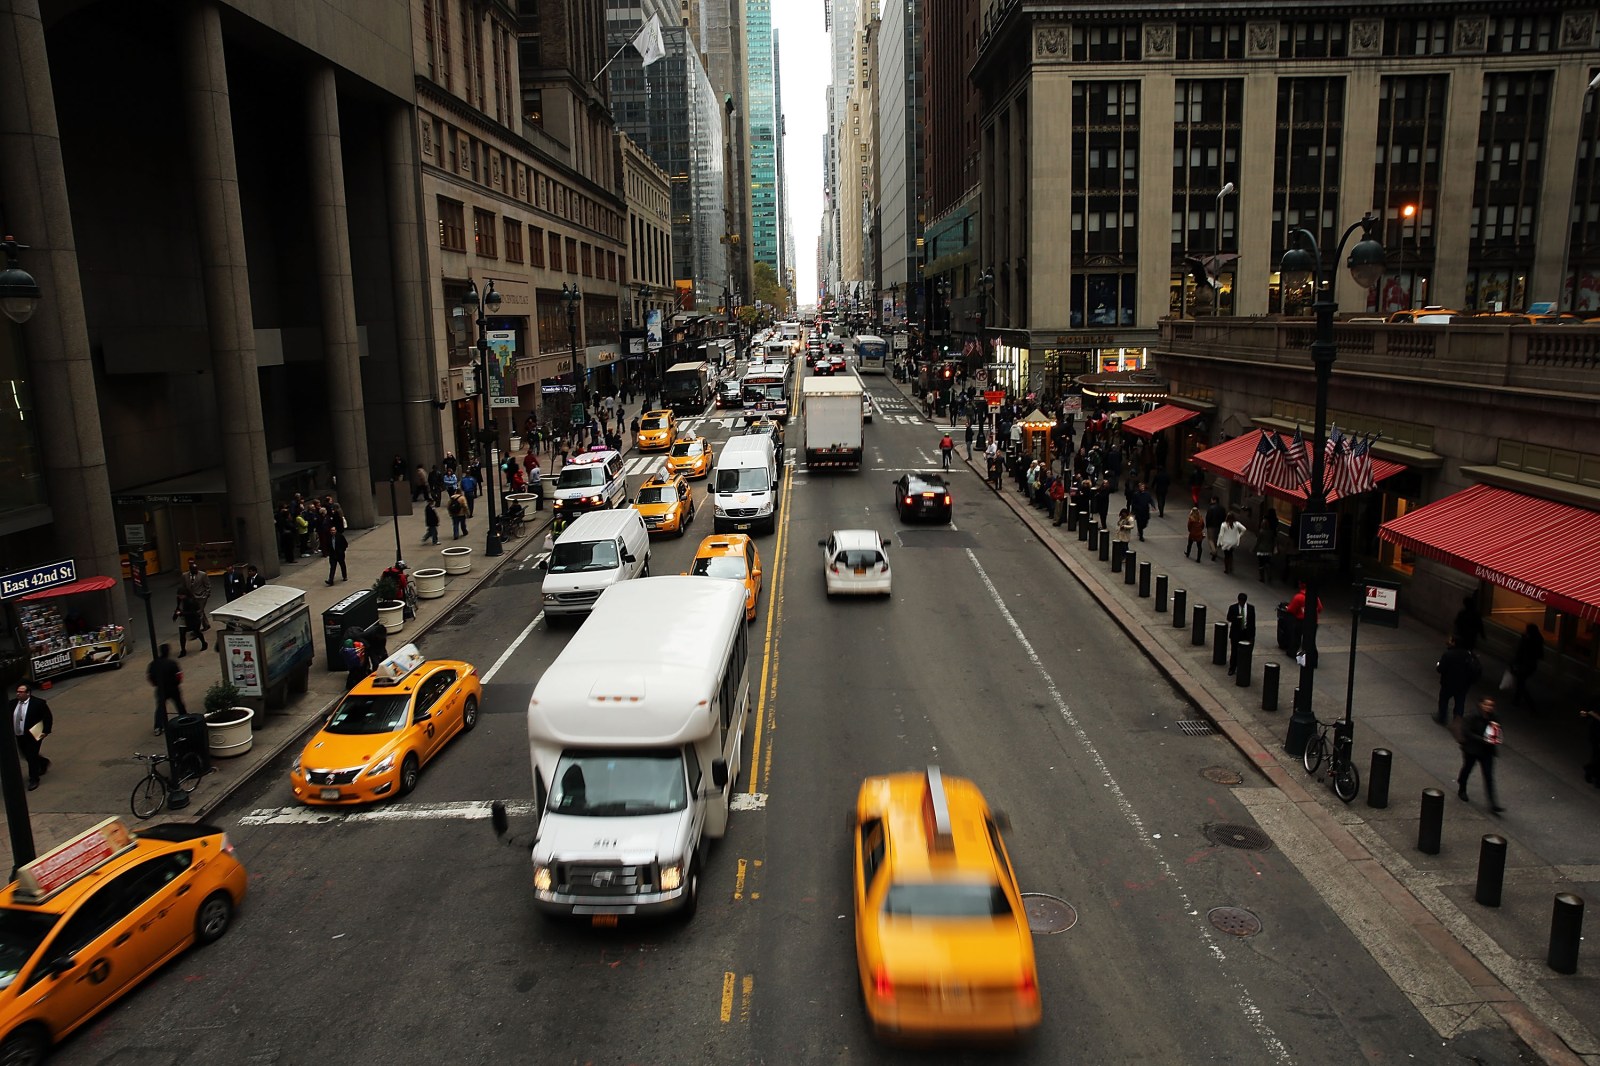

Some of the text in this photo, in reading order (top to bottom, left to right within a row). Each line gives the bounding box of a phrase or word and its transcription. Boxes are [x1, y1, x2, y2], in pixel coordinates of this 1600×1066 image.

[2, 566, 73, 594] East 42nd St
[1475, 565, 1549, 602] BANANA REPUBLIC
[34, 652, 71, 670] Beautiful
